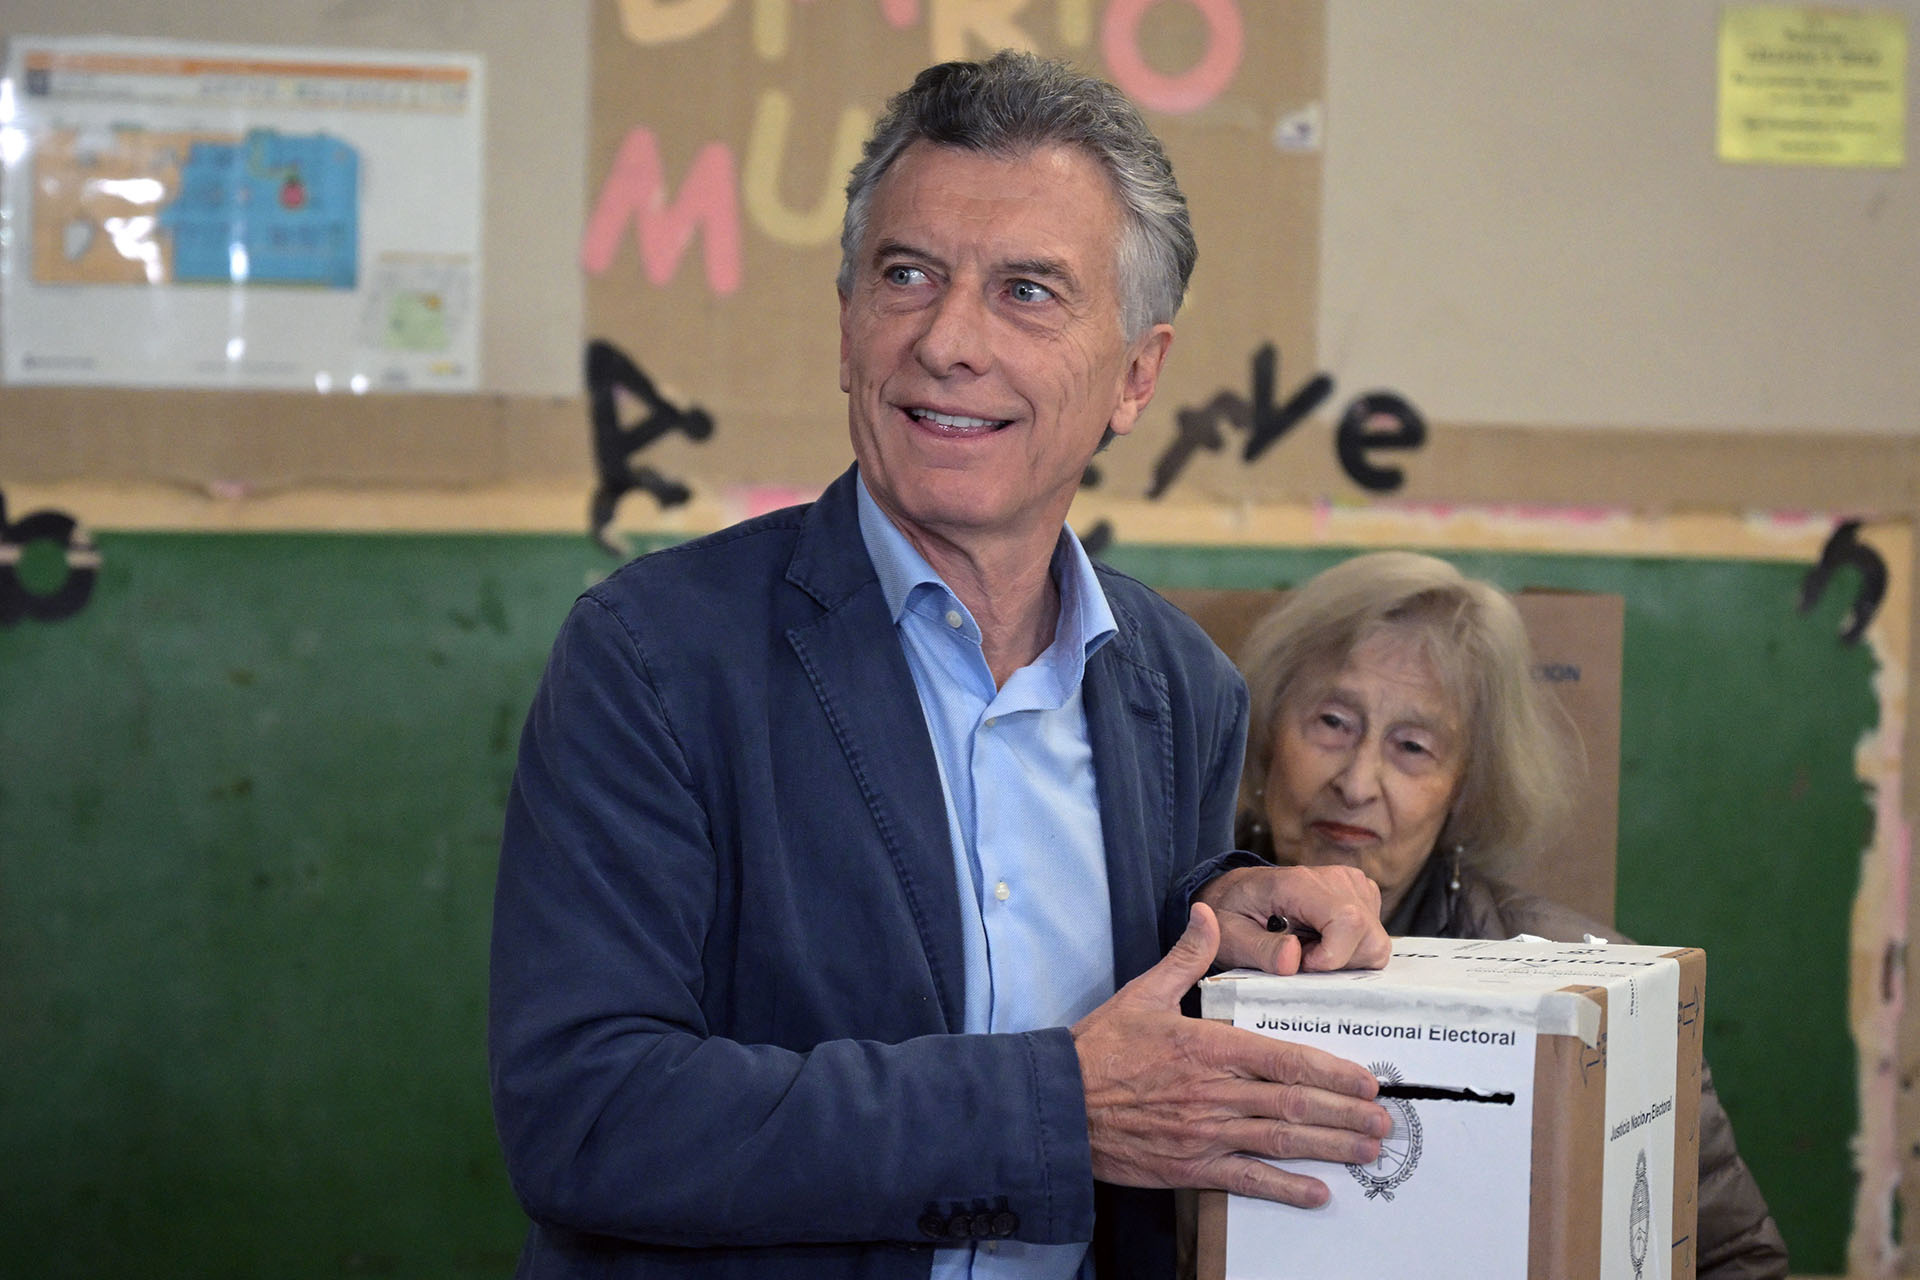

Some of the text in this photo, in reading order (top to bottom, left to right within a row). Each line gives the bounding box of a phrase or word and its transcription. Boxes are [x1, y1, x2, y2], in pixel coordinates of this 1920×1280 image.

[1451, 955, 1656, 967] seguridad
[1255, 1012, 1516, 1047] Justicia Nacional Electoral
